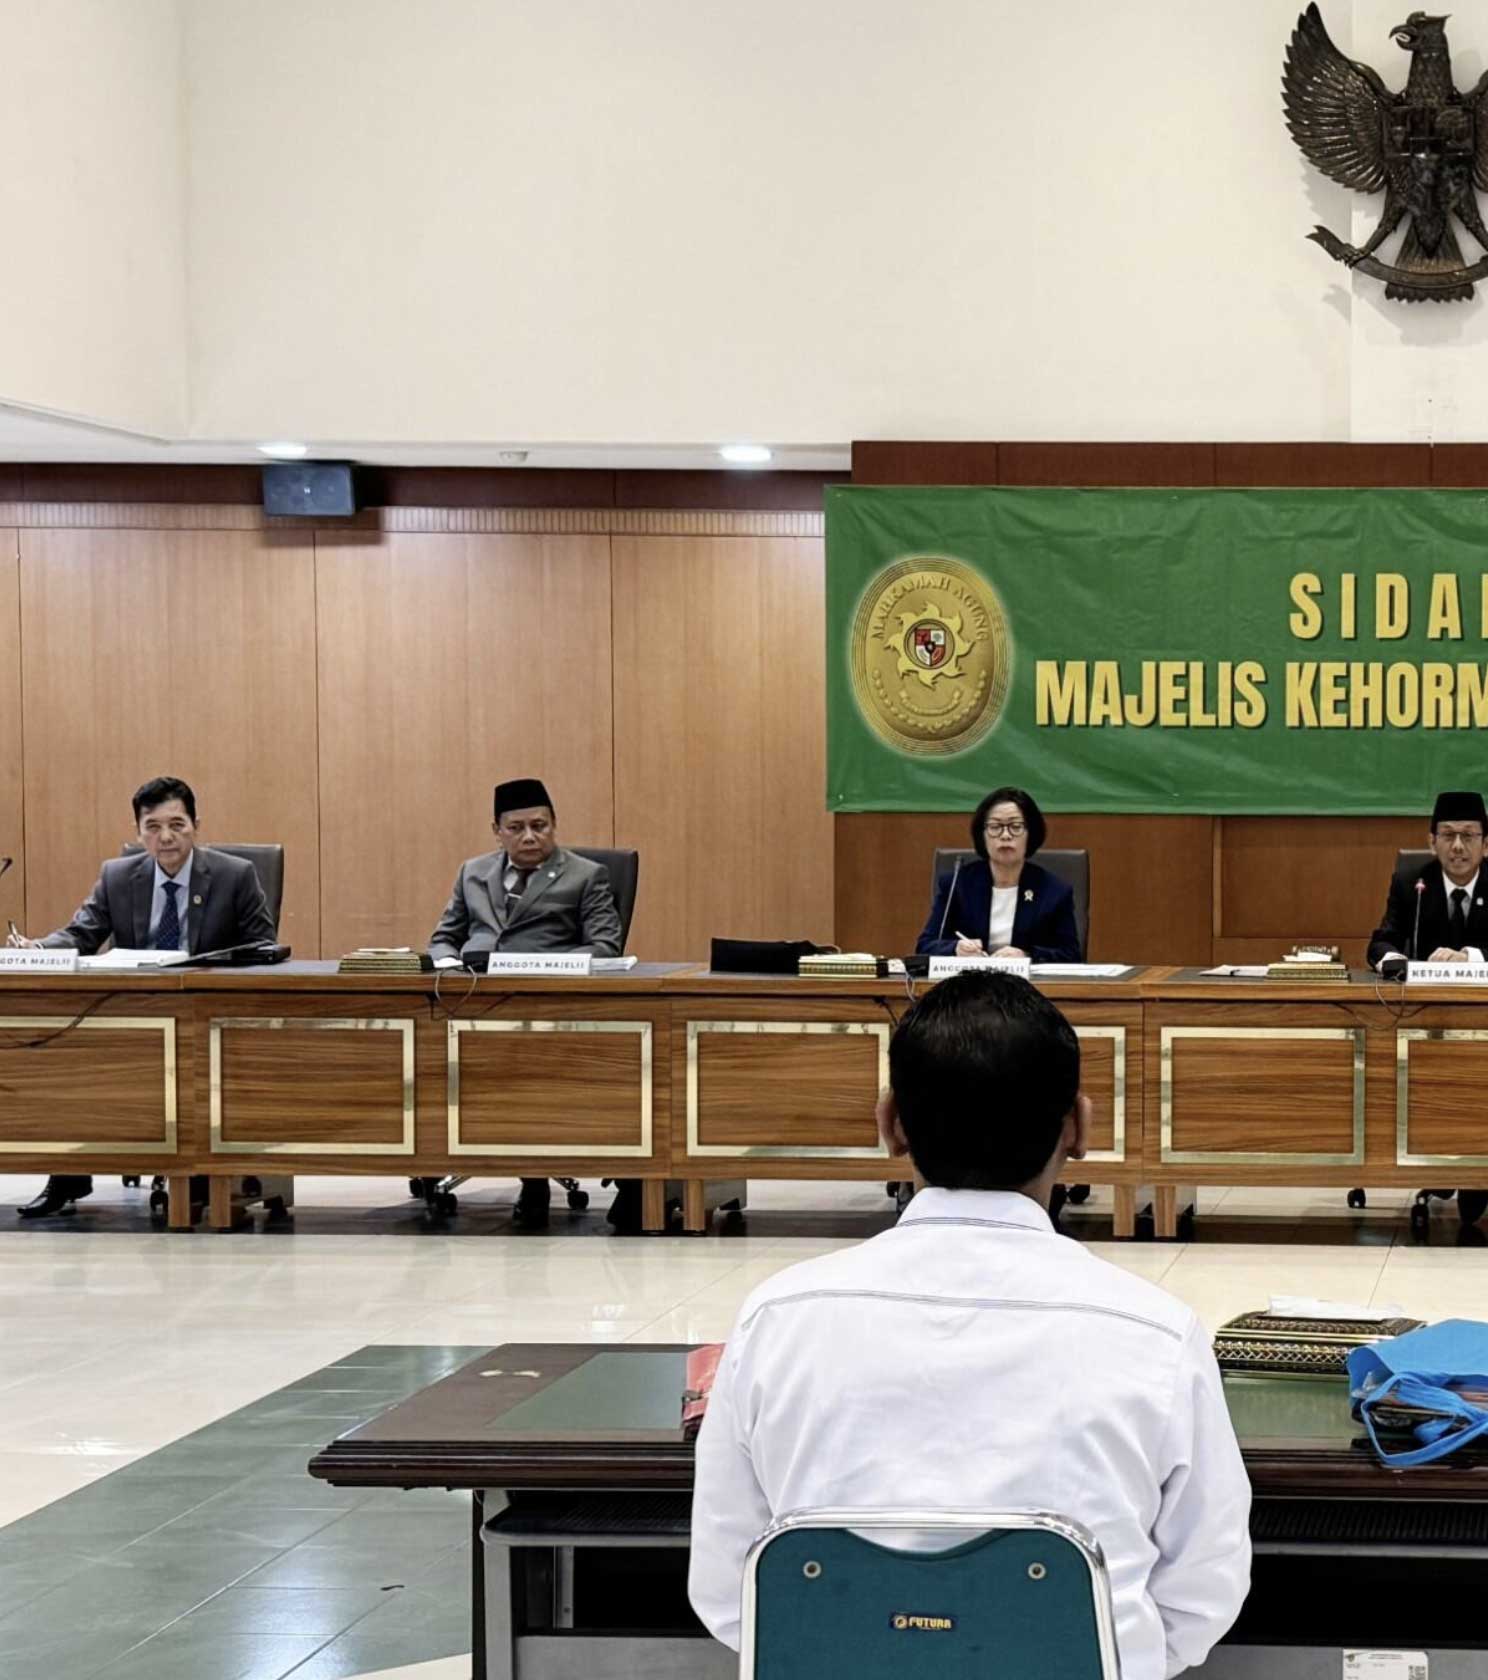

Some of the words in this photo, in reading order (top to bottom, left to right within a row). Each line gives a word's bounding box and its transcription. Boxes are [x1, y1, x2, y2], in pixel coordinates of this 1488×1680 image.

[1036, 661, 1266, 727] MAJELIS
[492, 961, 541, 969] ANGGOTA
[1412, 969, 1450, 978] KETUA
[908, 1616, 951, 1629] FUTURA
